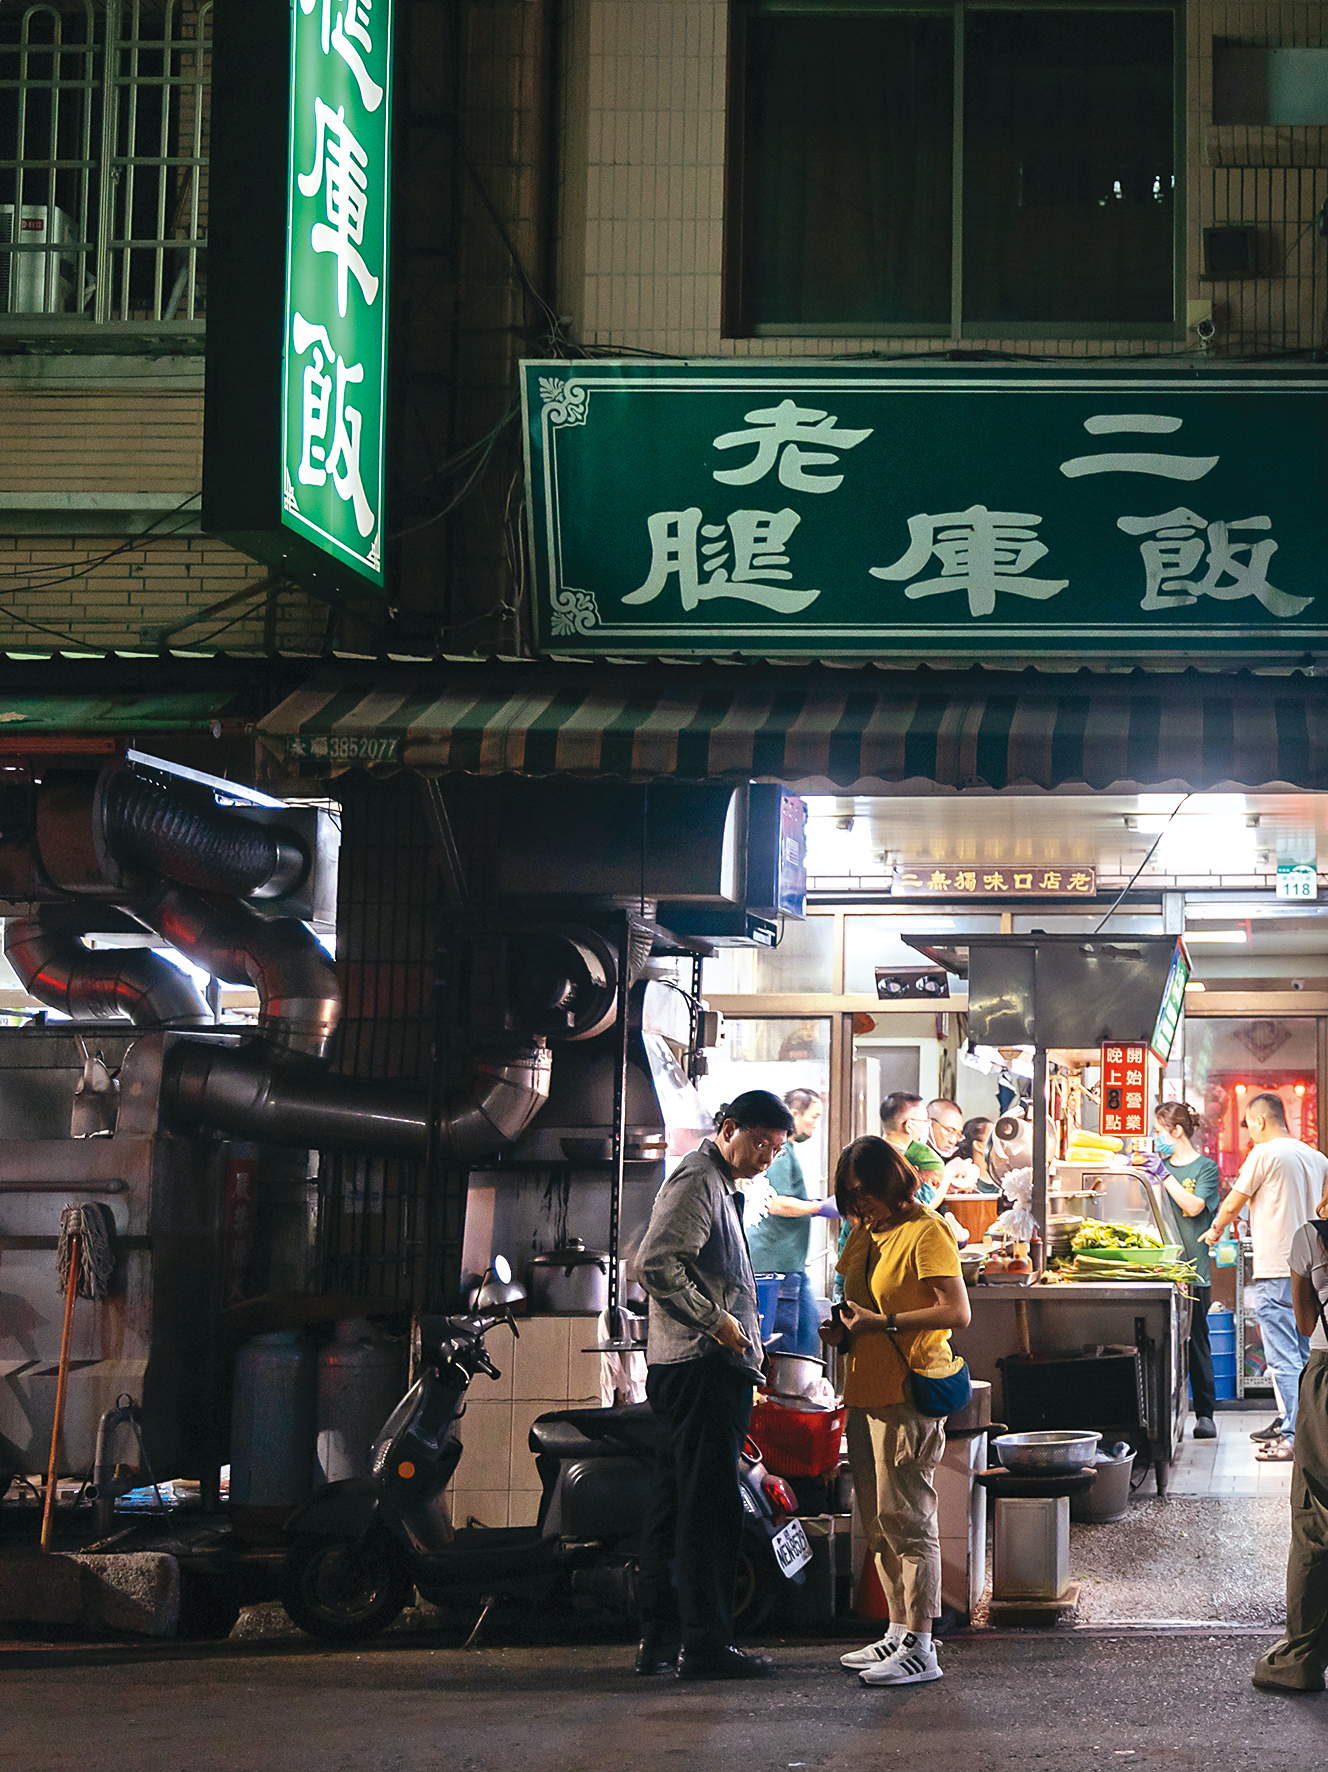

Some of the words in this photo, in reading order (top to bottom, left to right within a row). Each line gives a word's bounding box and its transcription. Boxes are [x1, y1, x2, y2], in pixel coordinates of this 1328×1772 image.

[621, 505, 1315, 617] 腿庫飯
[1283, 883, 1310, 895] 118
[1105, 1047, 1123, 1131] 晚上8點
[1125, 1048, 1142, 1130] 開始營業
